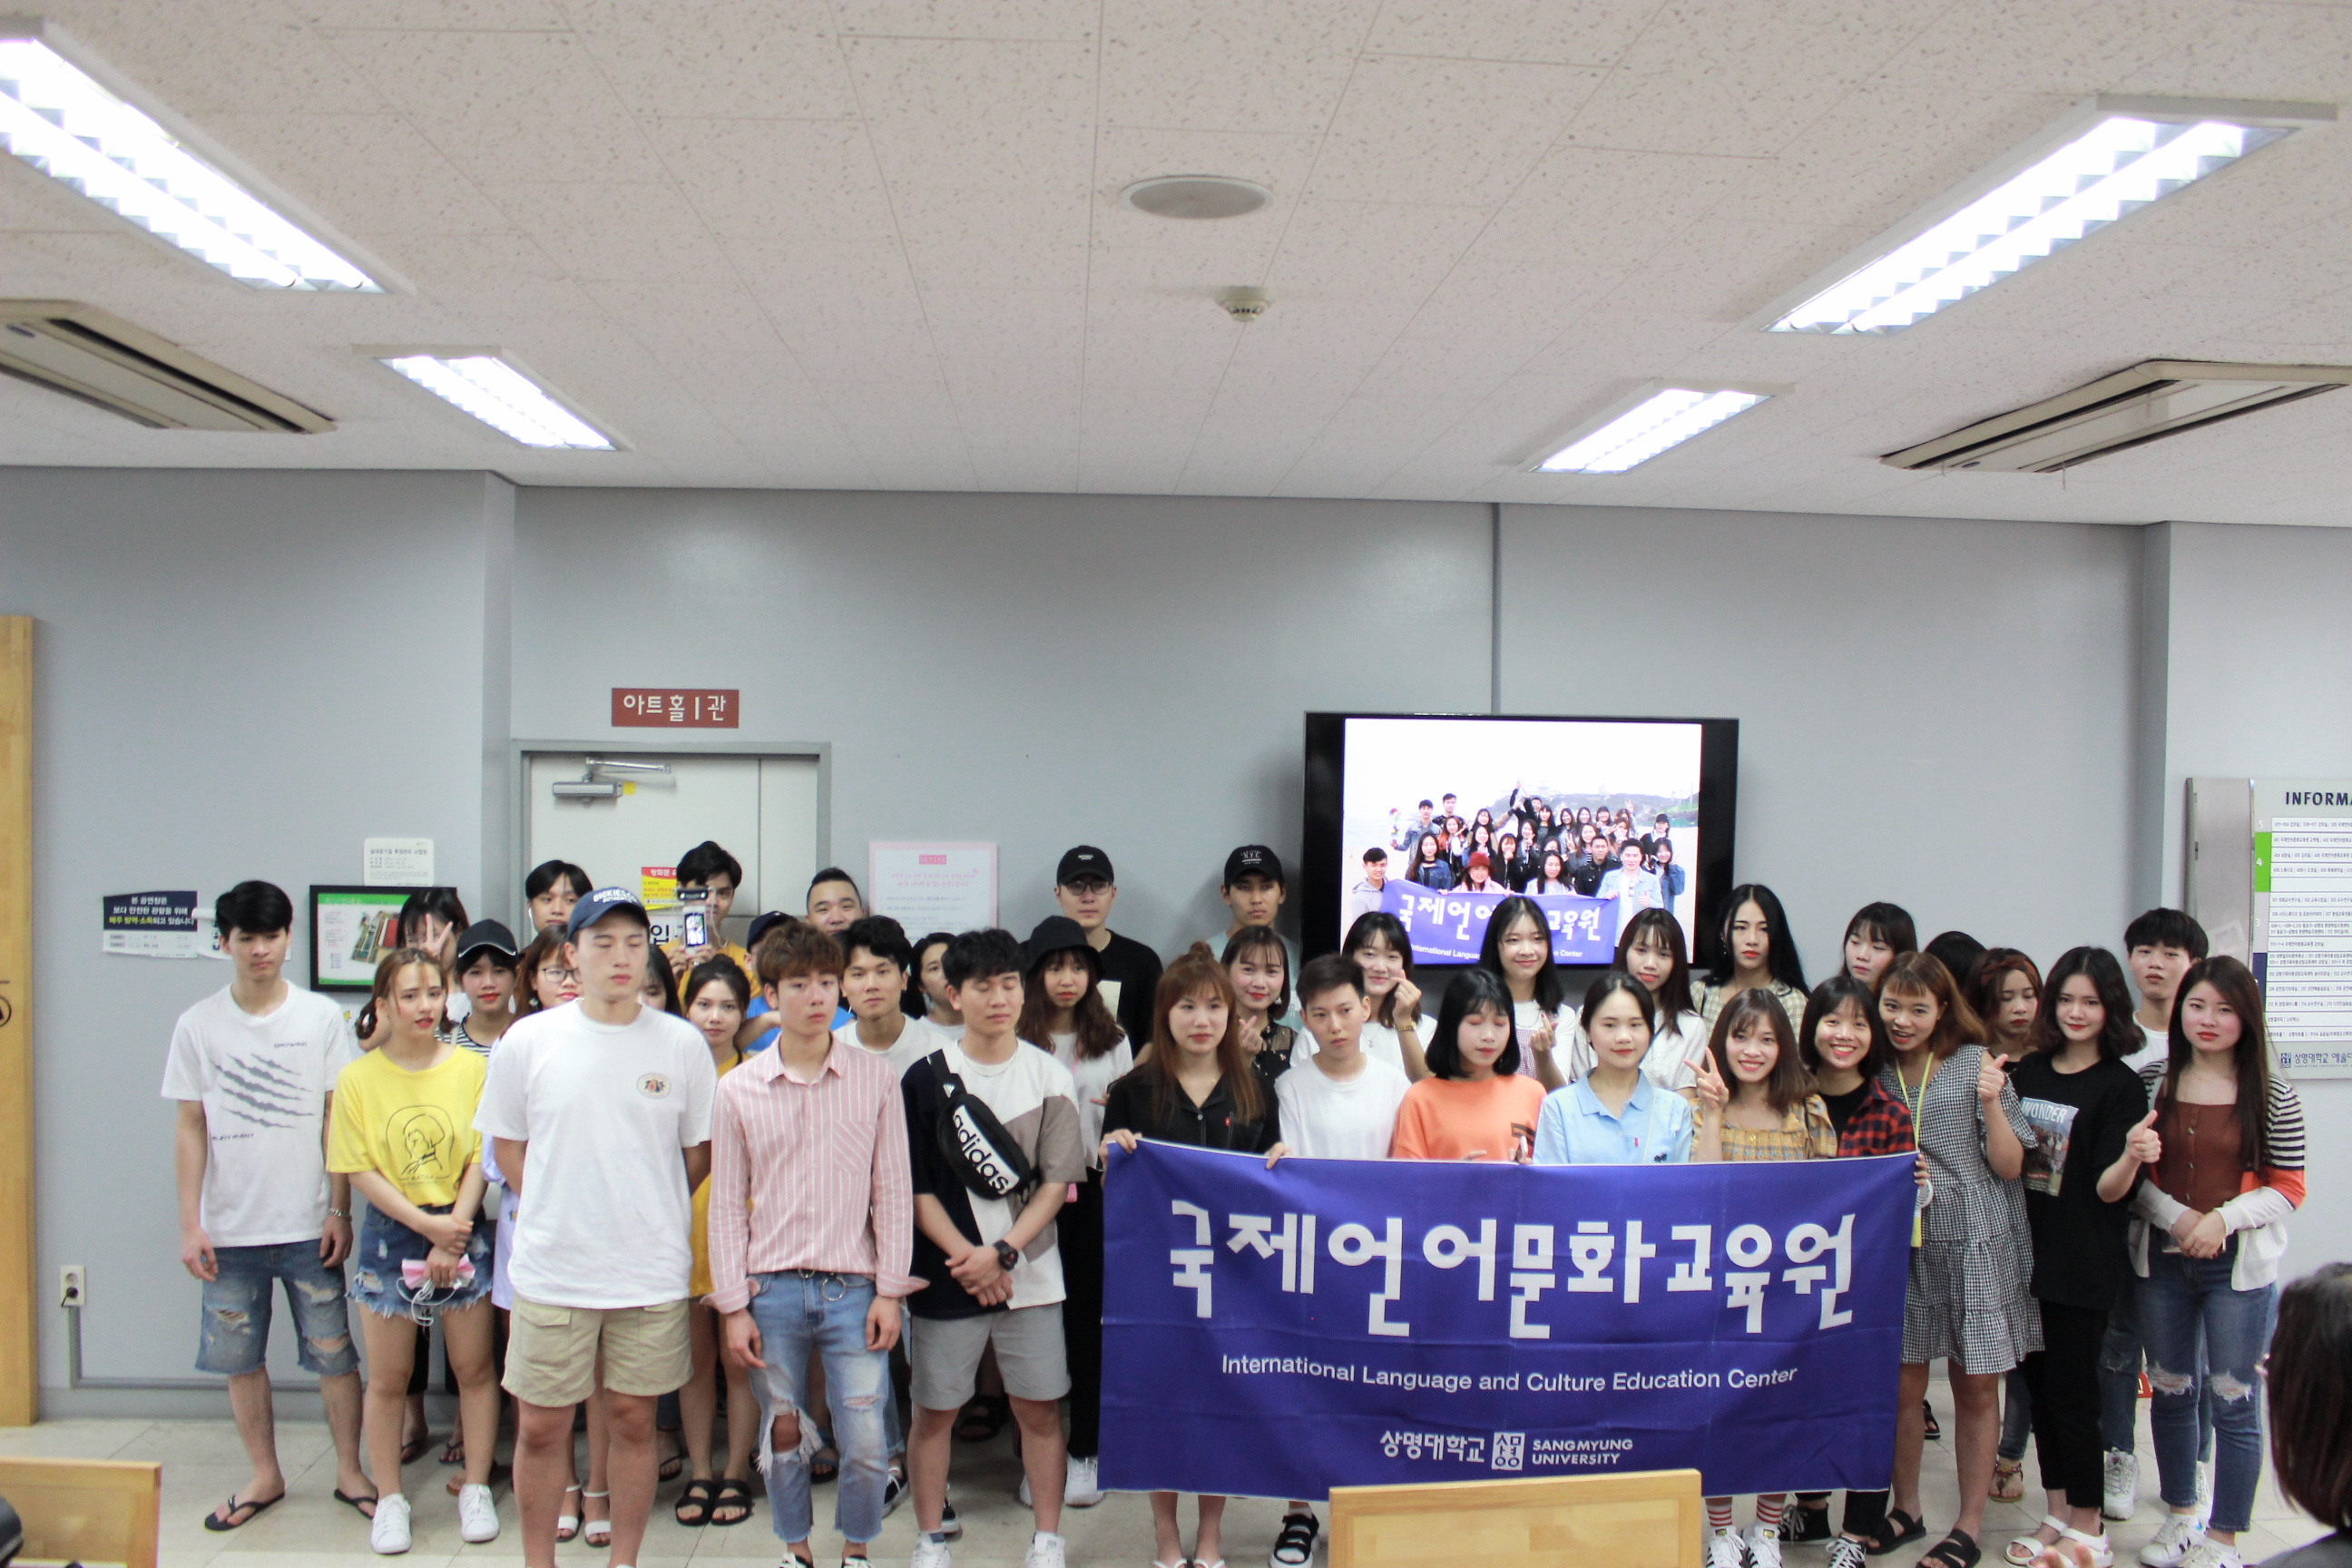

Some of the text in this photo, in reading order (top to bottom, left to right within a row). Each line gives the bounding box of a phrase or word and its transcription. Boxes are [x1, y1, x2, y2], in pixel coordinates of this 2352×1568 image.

[2285, 791, 2352, 807] INFORM
[2259, 820, 2264, 829] 5
[2256, 858, 2263, 867] 4
[1560, 949, 1583, 958] Center
[2020, 1101, 2068, 1123] WONDER
[954, 1114, 1009, 1193] adidas
[1170, 1200, 1857, 1339] 국제언어문화교육원
[1222, 1355, 1798, 1393] International Language and Culture Education Center
[1380, 1430, 1485, 1464] 상명대학교
[1533, 1438, 1633, 1452] SANGMYUNG
[1532, 1453, 1621, 1465] UNIVERSITY
